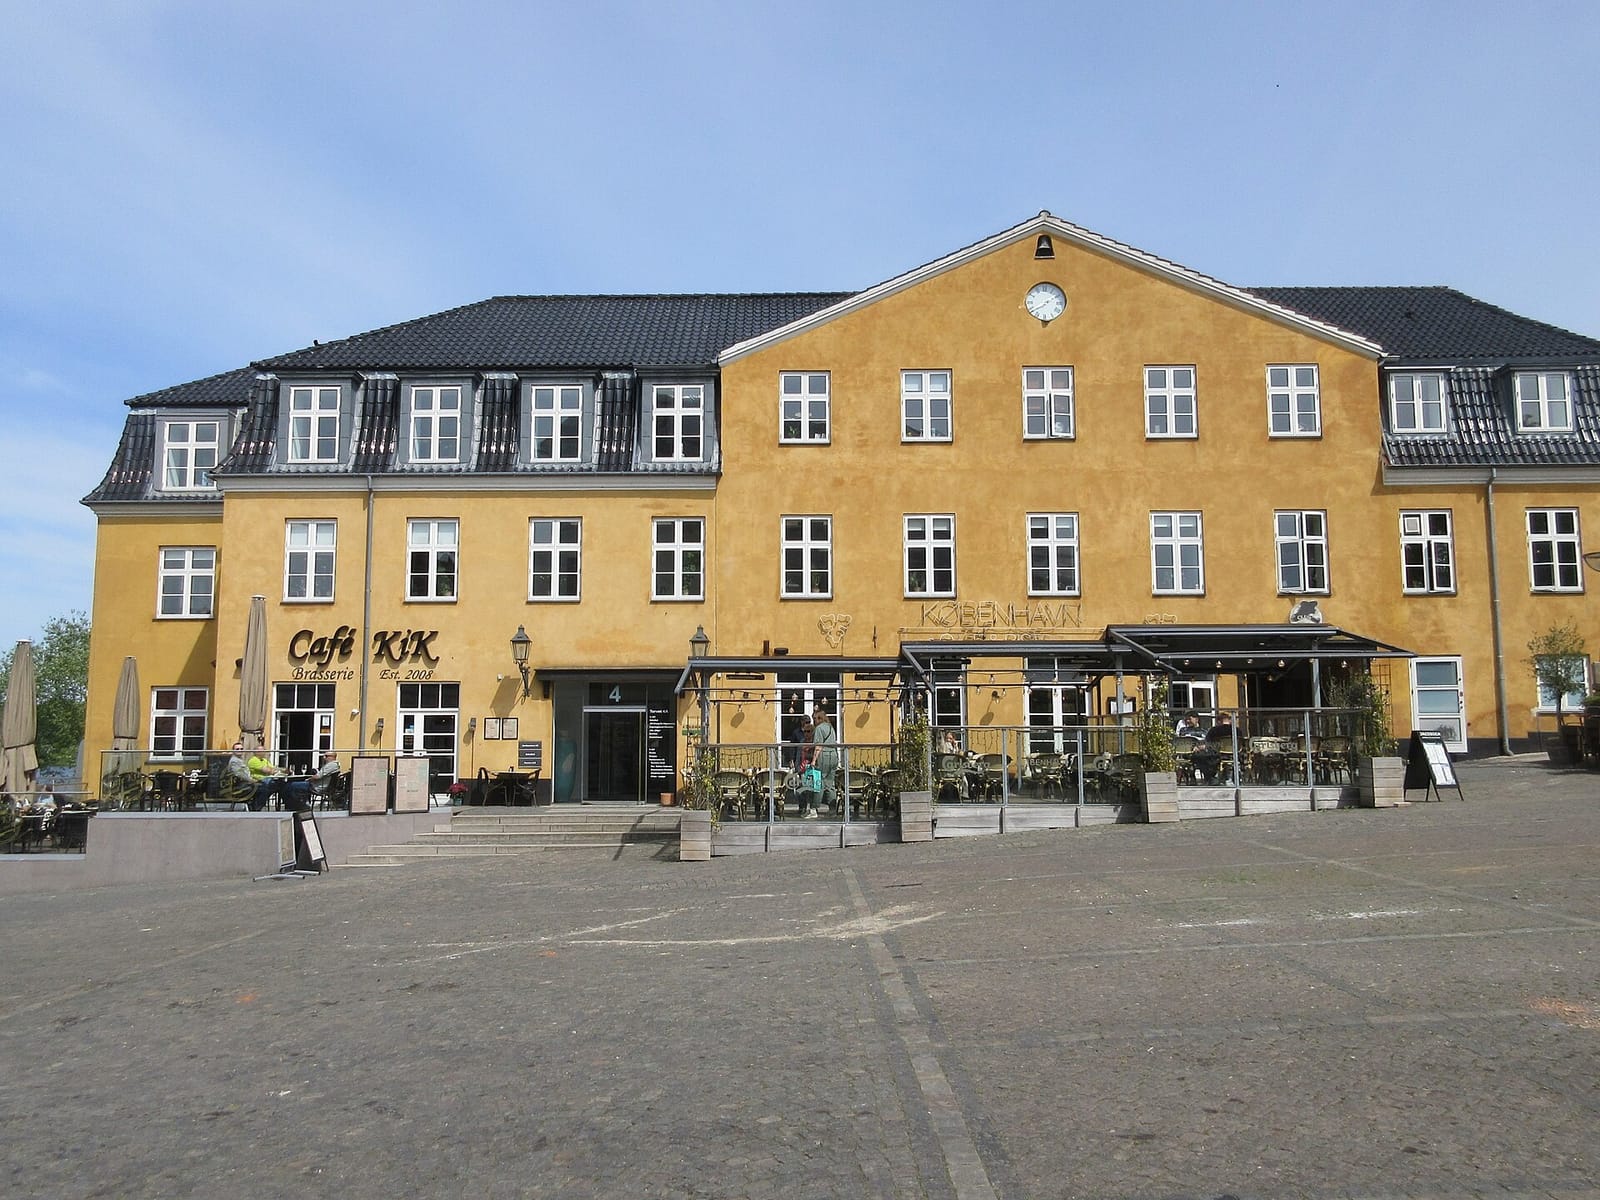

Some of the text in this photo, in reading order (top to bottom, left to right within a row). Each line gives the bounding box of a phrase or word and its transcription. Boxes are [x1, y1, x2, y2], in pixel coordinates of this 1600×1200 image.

[921, 600, 1081, 627] KØBENHAVN
[289, 625, 440, 665] Café KiK
[292, 667, 354, 680] Brasserie
[380, 669, 434, 680] Est. 2008
[608, 685, 621, 702] 4
